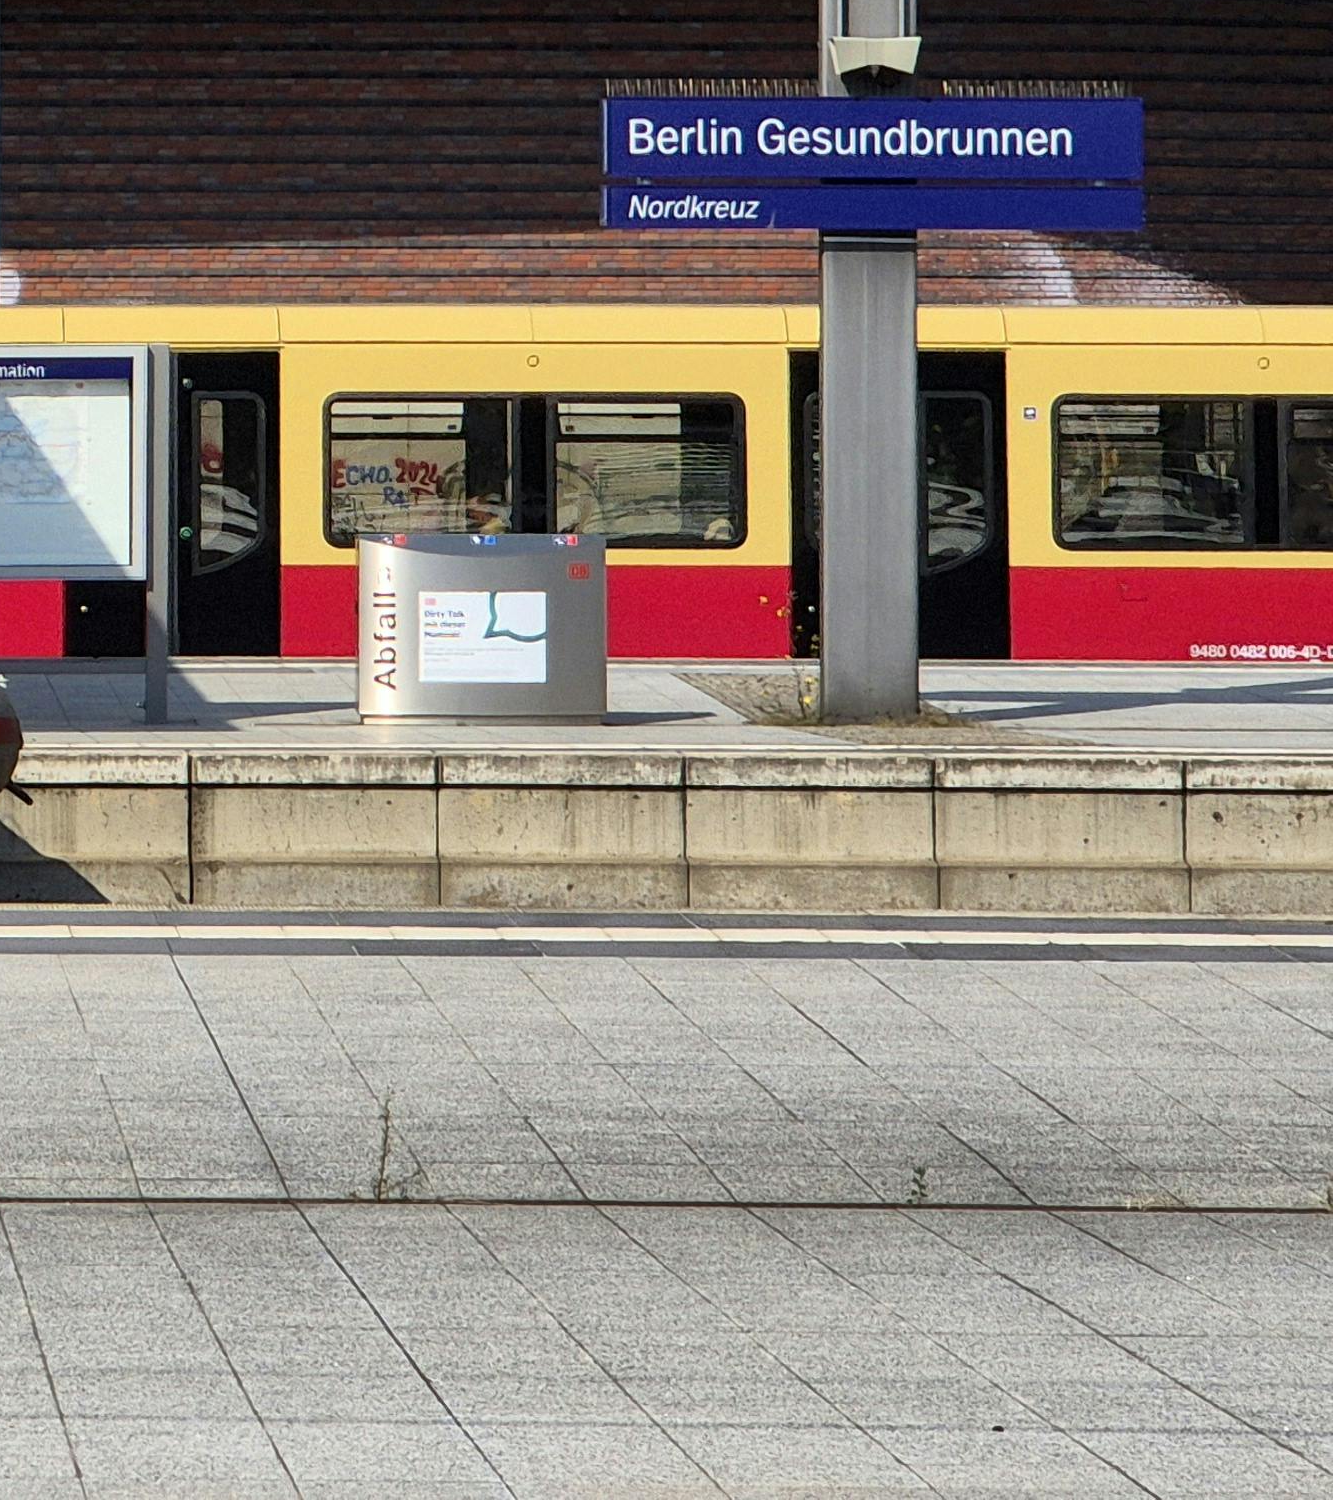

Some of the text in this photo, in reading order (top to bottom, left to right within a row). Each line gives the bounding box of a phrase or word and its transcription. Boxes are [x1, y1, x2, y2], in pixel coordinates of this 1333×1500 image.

[628, 118, 1074, 156] Berlin Gesundbrunnen
[628, 195, 760, 220] Nordkreuz
[373, 592, 396, 690] Abfall
[1189, 644, 1227, 657] 9480
[1230, 644, 1267, 658] 0482
